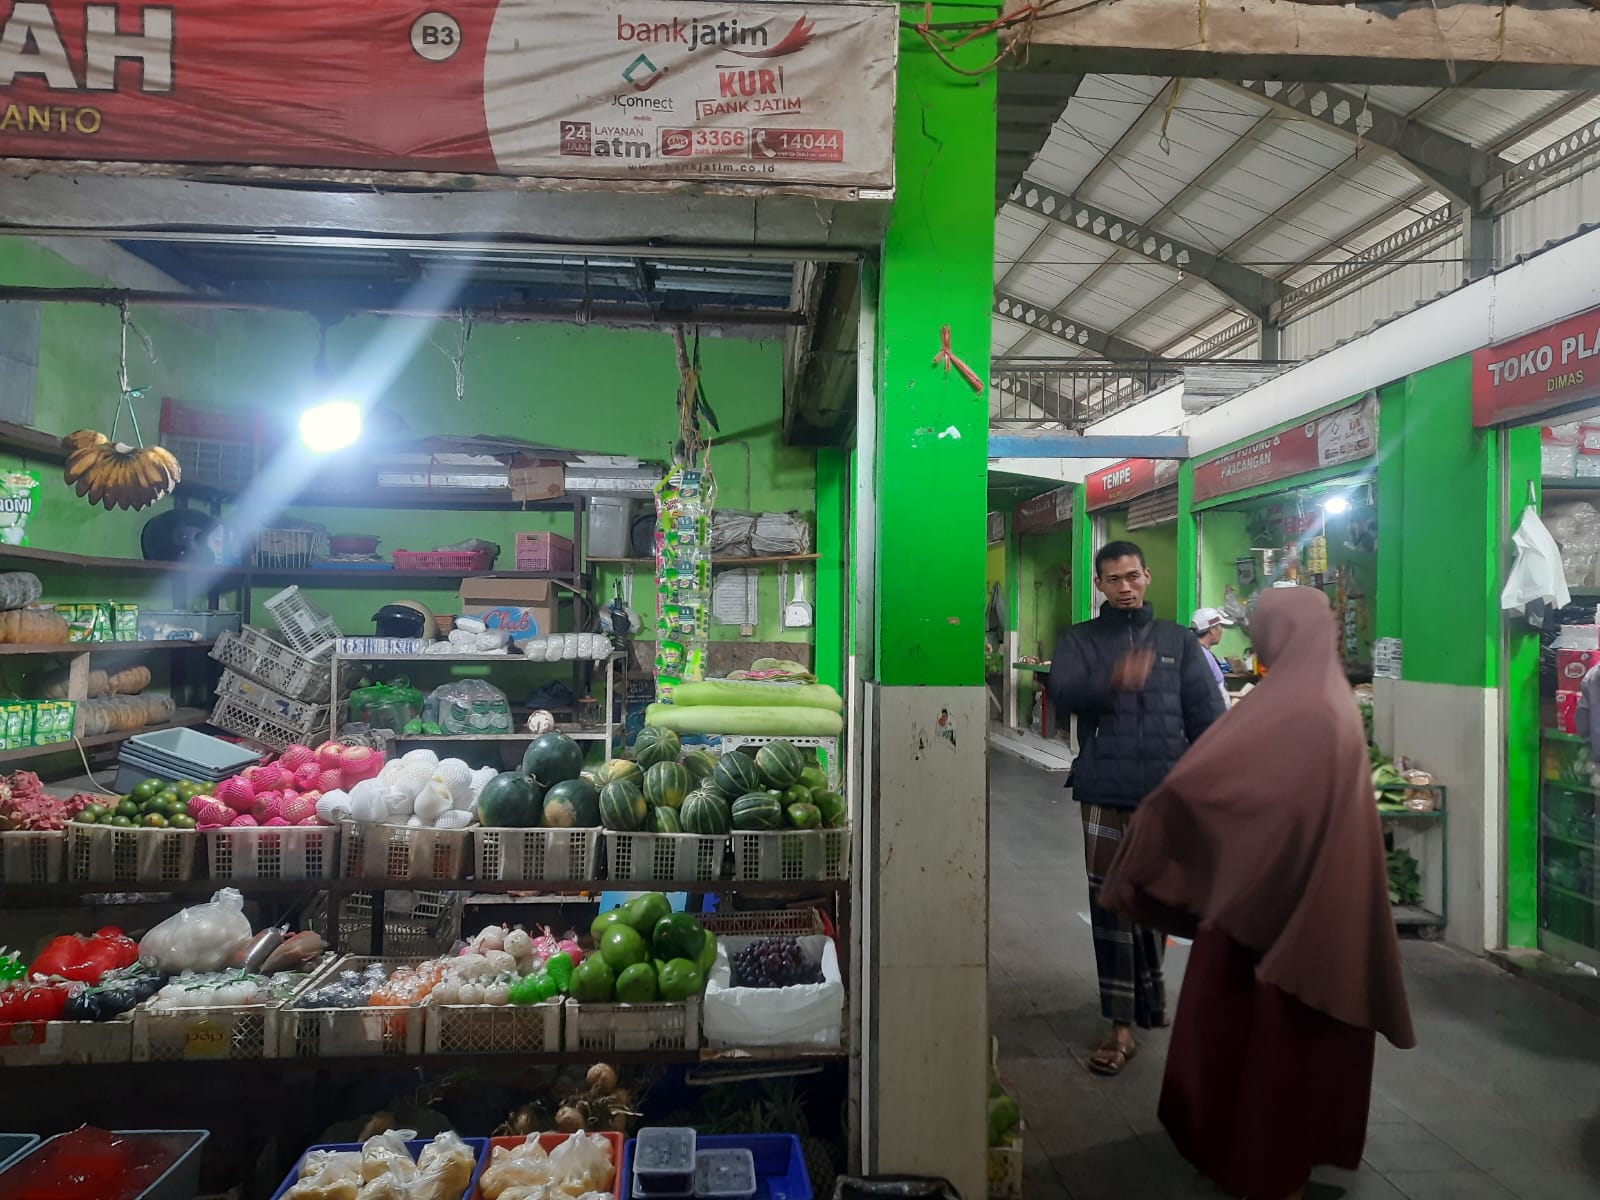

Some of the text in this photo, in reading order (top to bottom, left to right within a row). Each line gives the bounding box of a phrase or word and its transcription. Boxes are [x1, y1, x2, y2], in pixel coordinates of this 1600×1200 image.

[422, 26, 454, 45] B3
[617, 14, 768, 51] bankjatim
[718, 68, 776, 98] KUR
[611, 93, 673, 109] JConnect
[702, 96, 801, 116] BANK JATIM
[565, 124, 588, 140] 24
[595, 126, 644, 137] LAYANAN
[696, 130, 744, 146] 3366
[567, 142, 588, 151] JAM
[594, 137, 651, 158] atm
[668, 138, 687, 146] SMS
[780, 133, 838, 150] 14044
[1487, 345, 1553, 386] TOKO
[1547, 369, 1584, 392] DIMAS
[1102, 467, 1131, 491] TEMPE
[483, 610, 530, 631] Club
